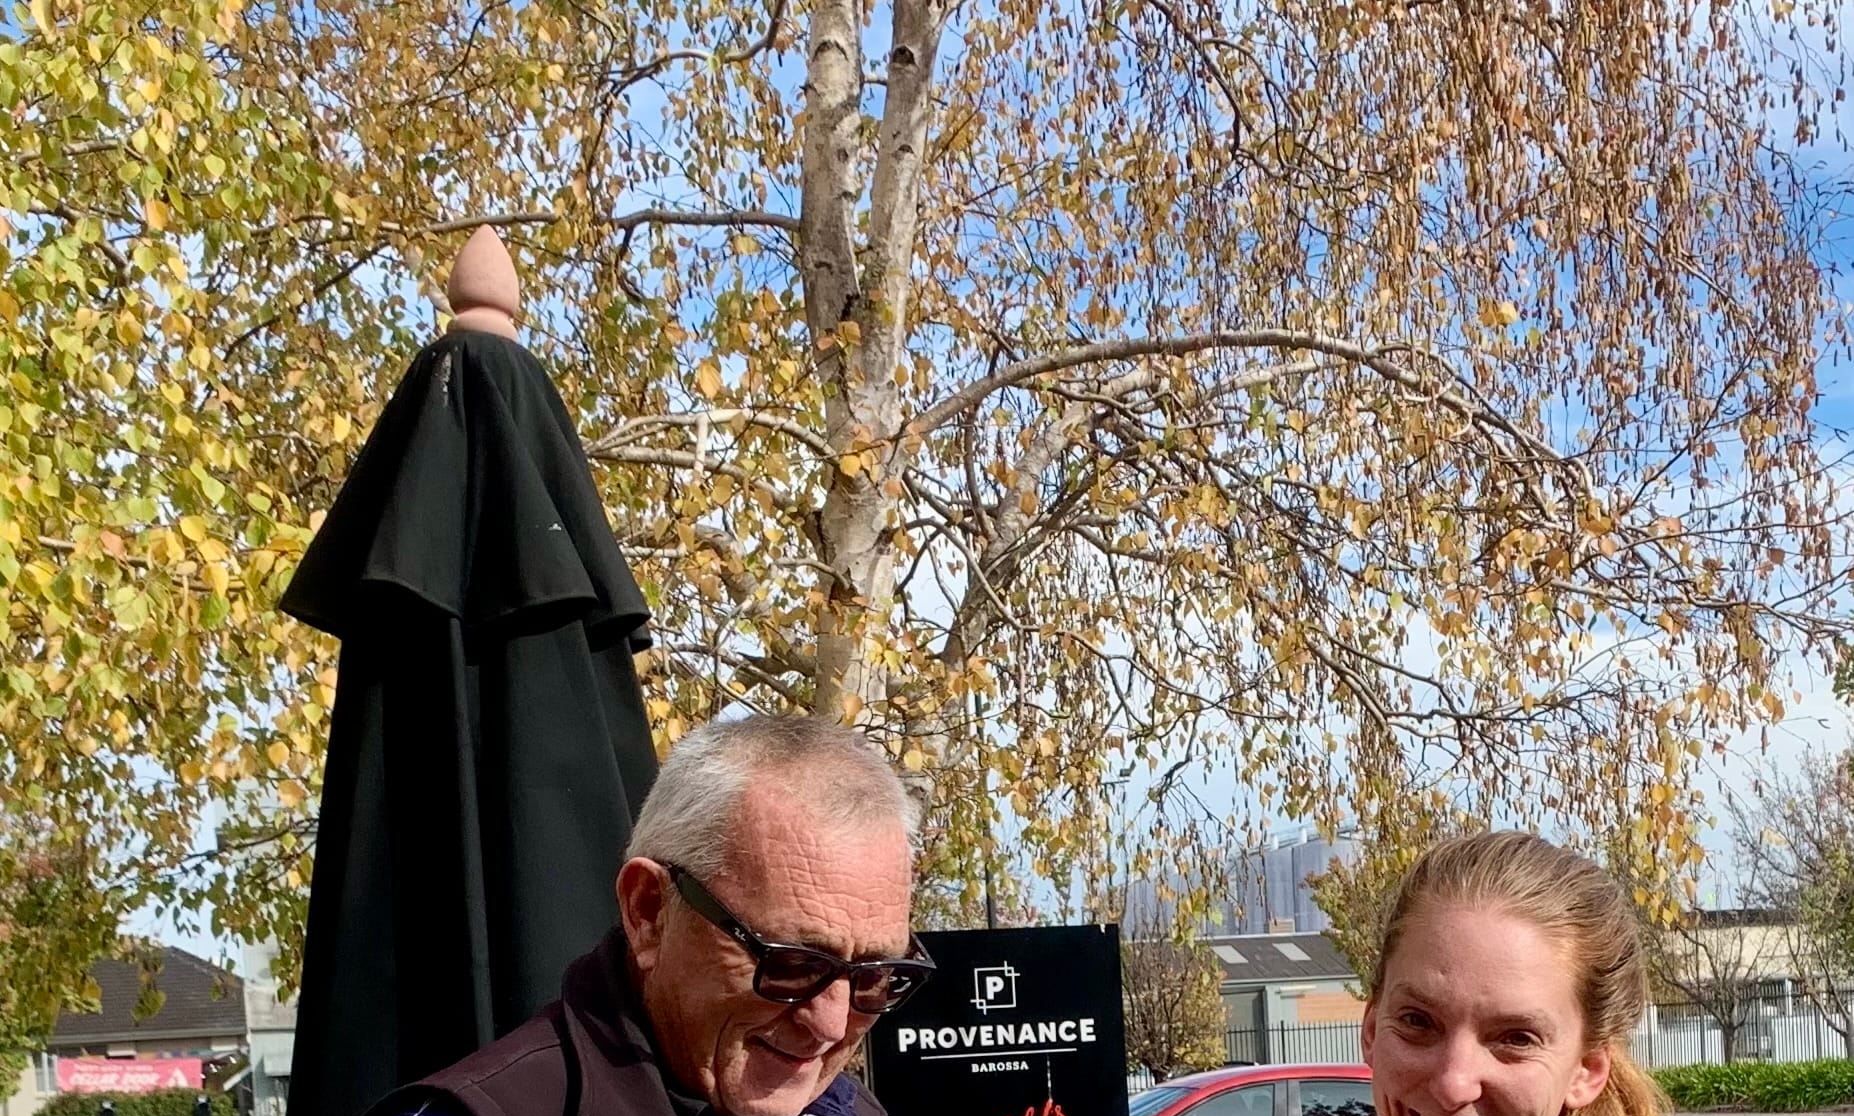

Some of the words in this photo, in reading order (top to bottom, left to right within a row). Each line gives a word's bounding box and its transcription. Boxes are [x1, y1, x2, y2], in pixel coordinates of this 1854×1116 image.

[985, 976, 1004, 1000] P
[898, 1018, 1097, 1053] PROVENANCE
[971, 1061, 1029, 1073] BAROSSA
